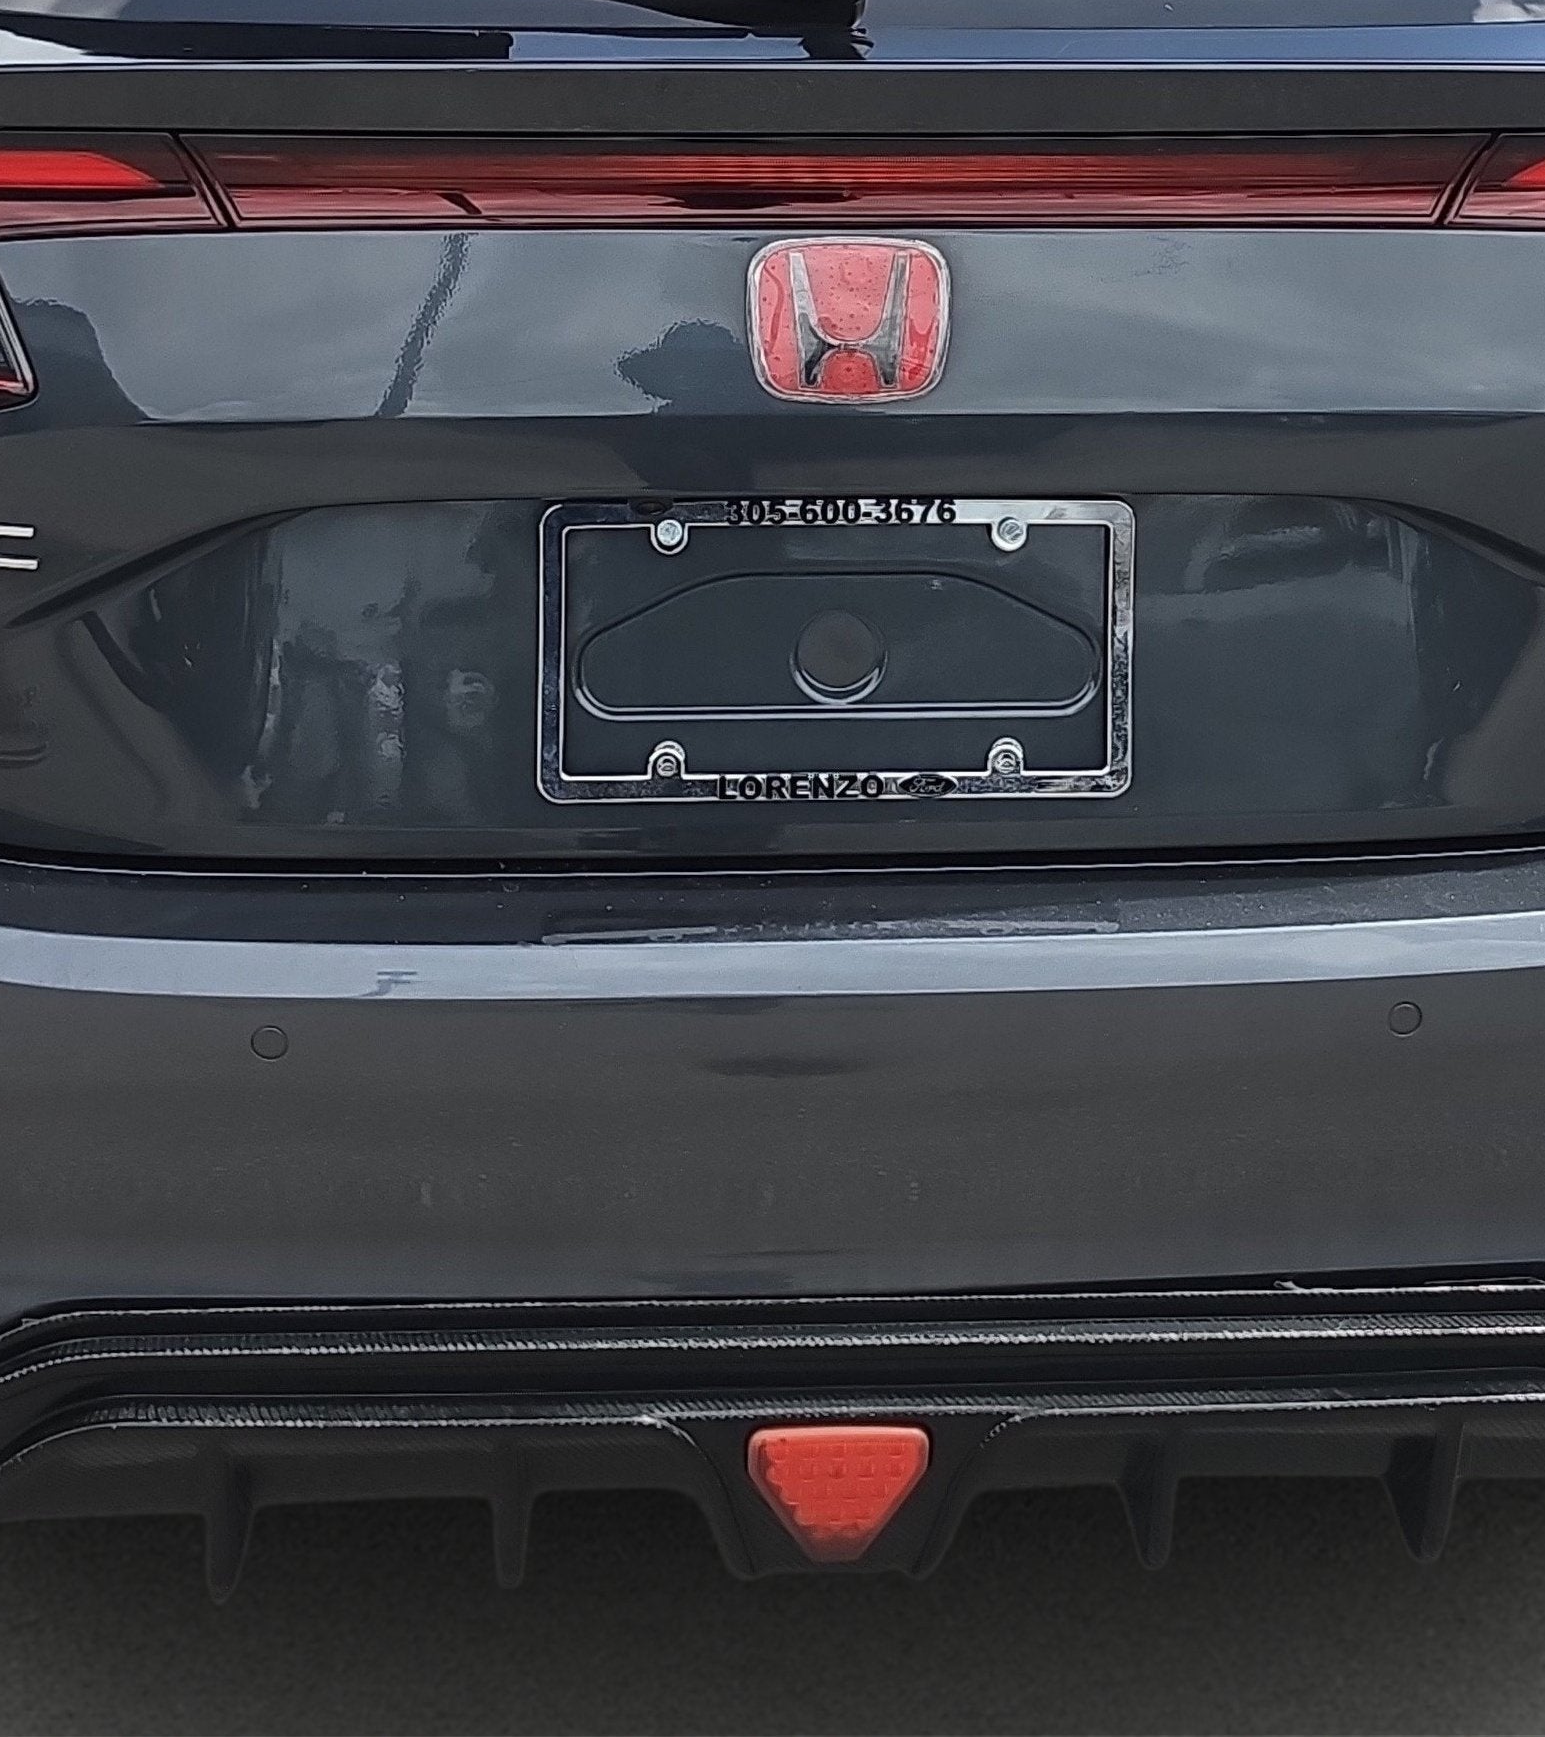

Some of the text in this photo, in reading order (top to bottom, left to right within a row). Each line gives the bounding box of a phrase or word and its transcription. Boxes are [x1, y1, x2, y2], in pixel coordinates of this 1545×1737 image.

[725, 498, 956, 525] 305-600-3676
[718, 773, 947, 800] LORENZO Ford
